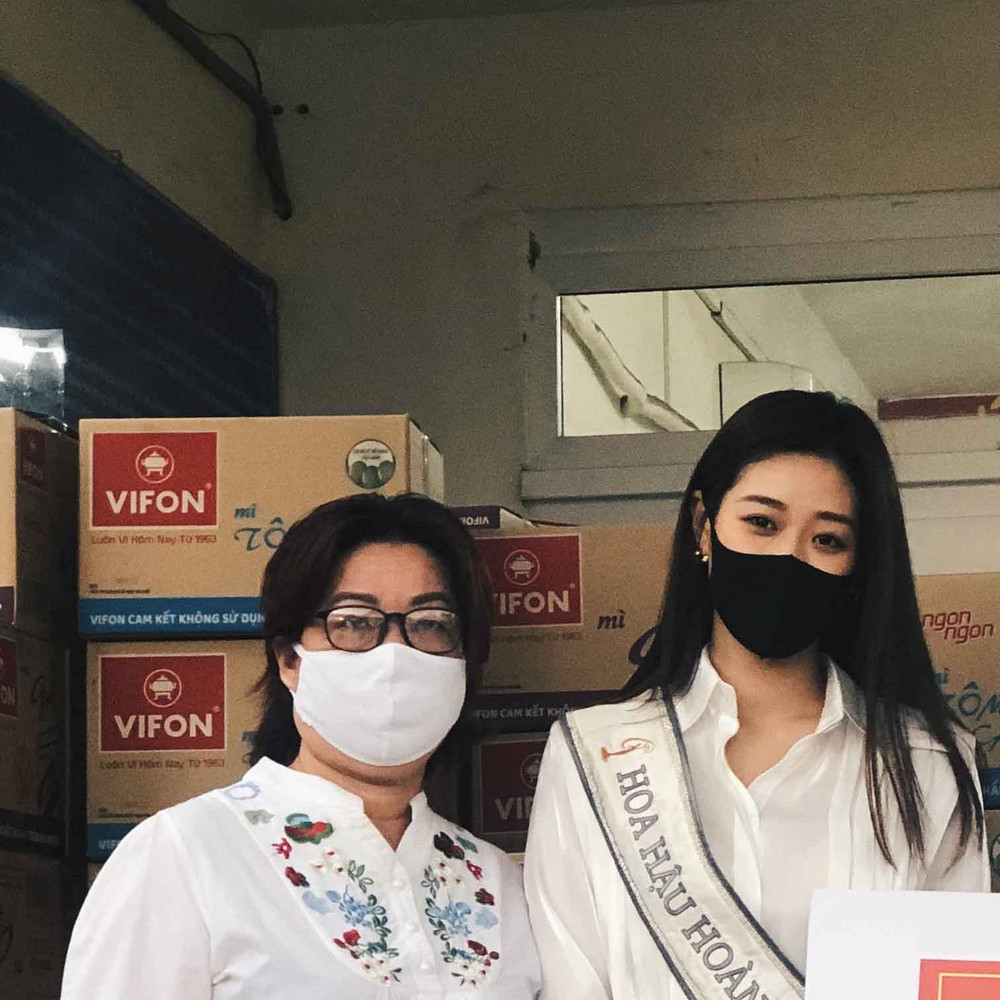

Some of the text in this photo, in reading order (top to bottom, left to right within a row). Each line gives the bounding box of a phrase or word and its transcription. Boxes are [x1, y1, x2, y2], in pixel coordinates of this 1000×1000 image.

[106, 489, 205, 514] VIFON
[493, 590, 569, 615] IFON
[90, 609, 238, 625] VIFON CAM KẾT KHÔNG SỬ
[597, 609, 626, 630] mì
[923, 611, 971, 631] ngon
[945, 623, 994, 644] ngon
[500, 708, 523, 719] CAM
[114, 713, 212, 739] VIFON
[617, 764, 659, 840] HOA
[640, 836, 696, 917] HẬU
